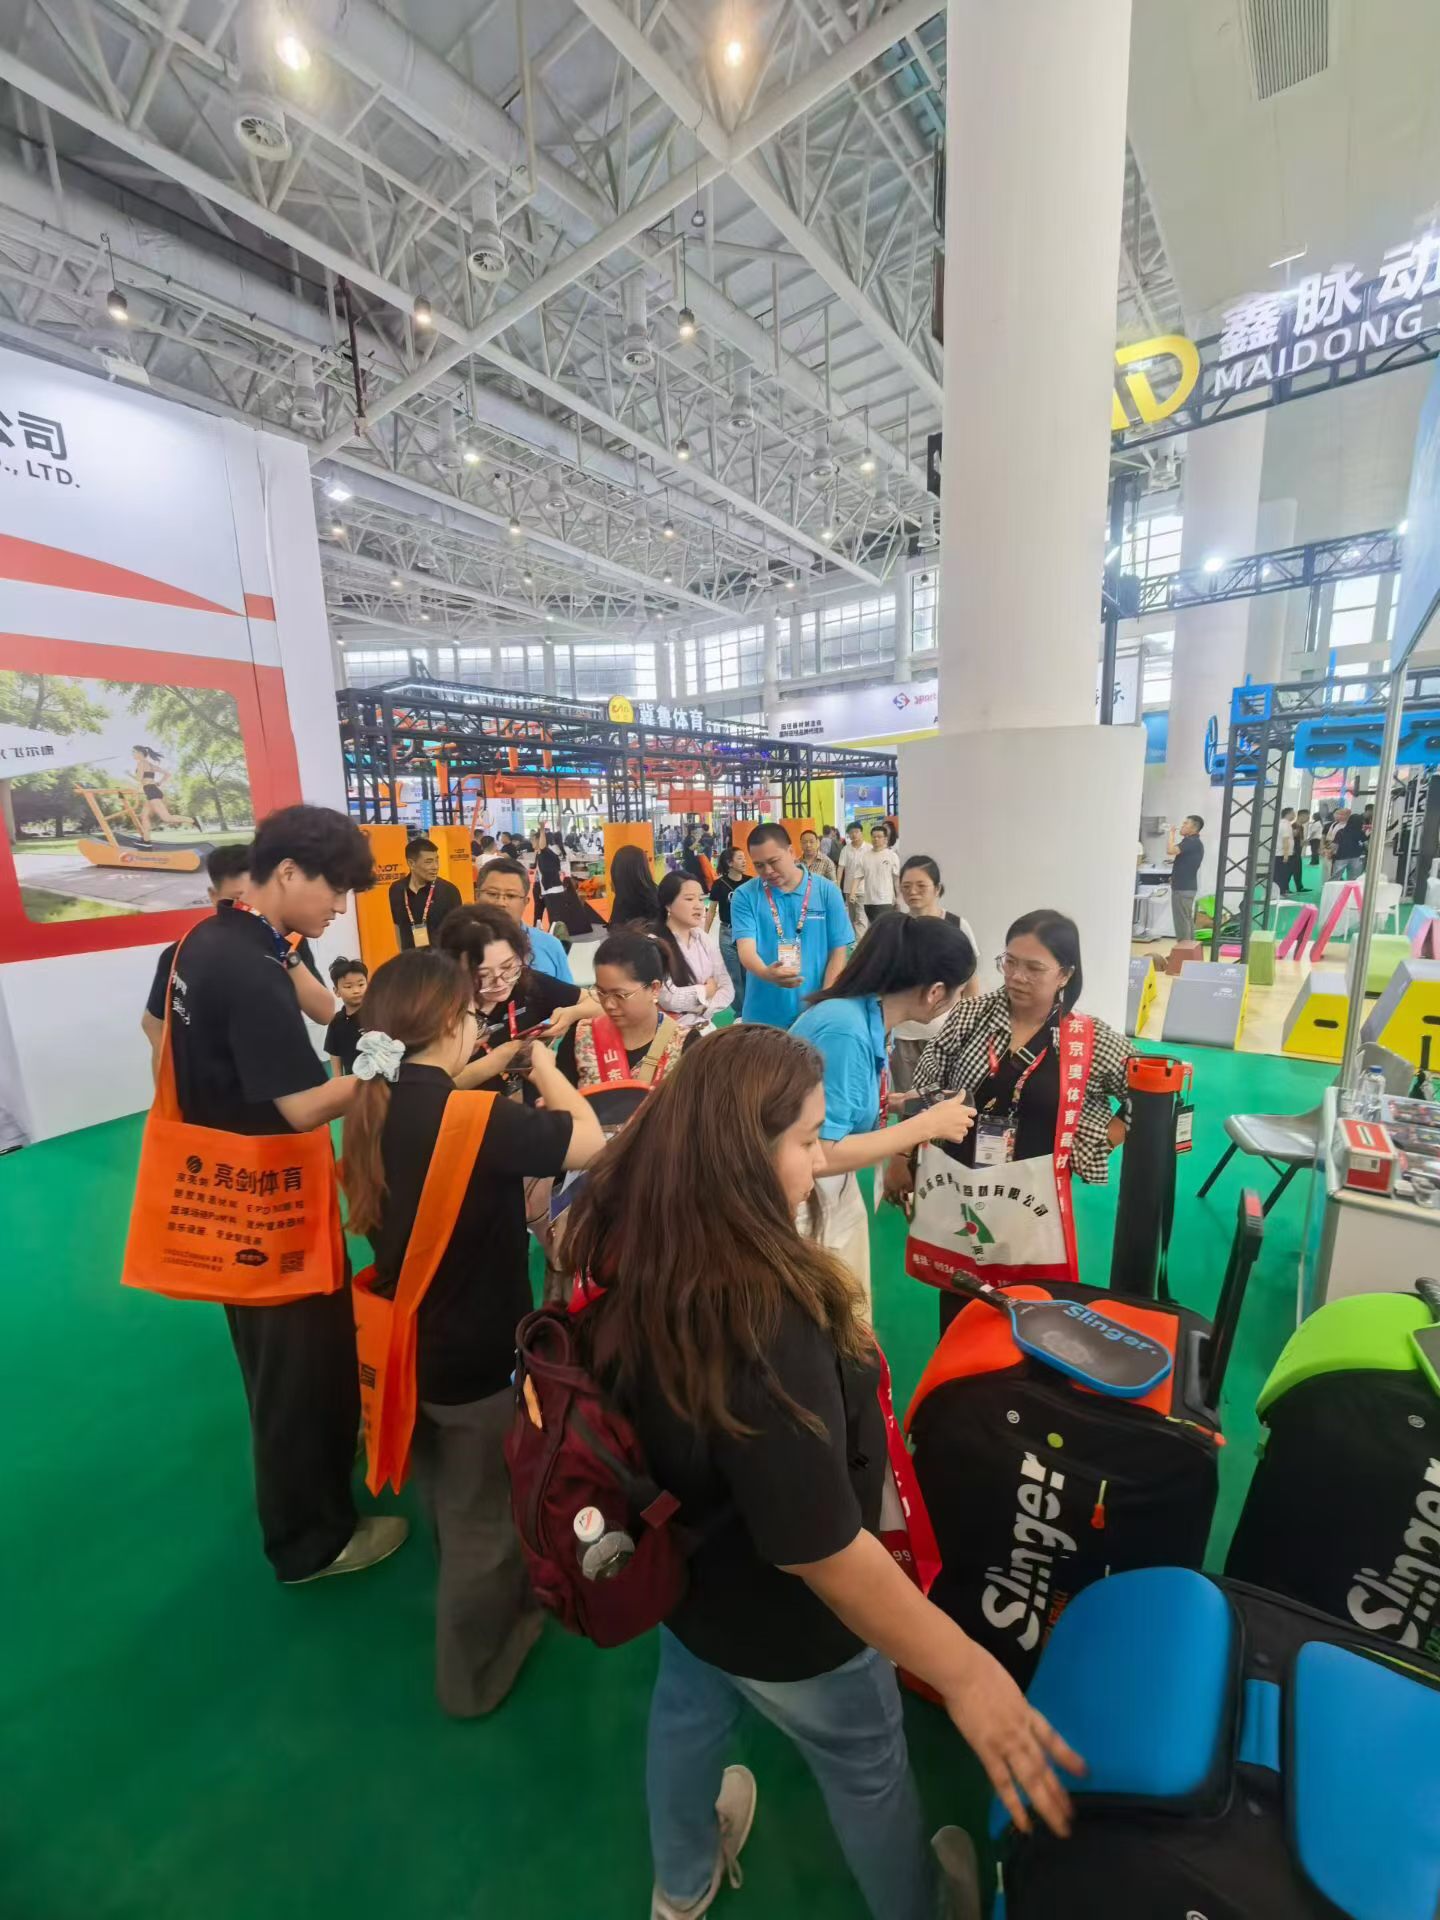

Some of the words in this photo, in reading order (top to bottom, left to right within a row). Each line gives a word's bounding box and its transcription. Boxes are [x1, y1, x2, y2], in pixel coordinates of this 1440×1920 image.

[1212, 303, 1424, 397] MAIDONG
[26, 459, 81, 489] LTD.
[213, 1163, 304, 1197] 亮剑体育
[1063, 1304, 1157, 1351] Slinger
[981, 1451, 1078, 1652] Slinger
